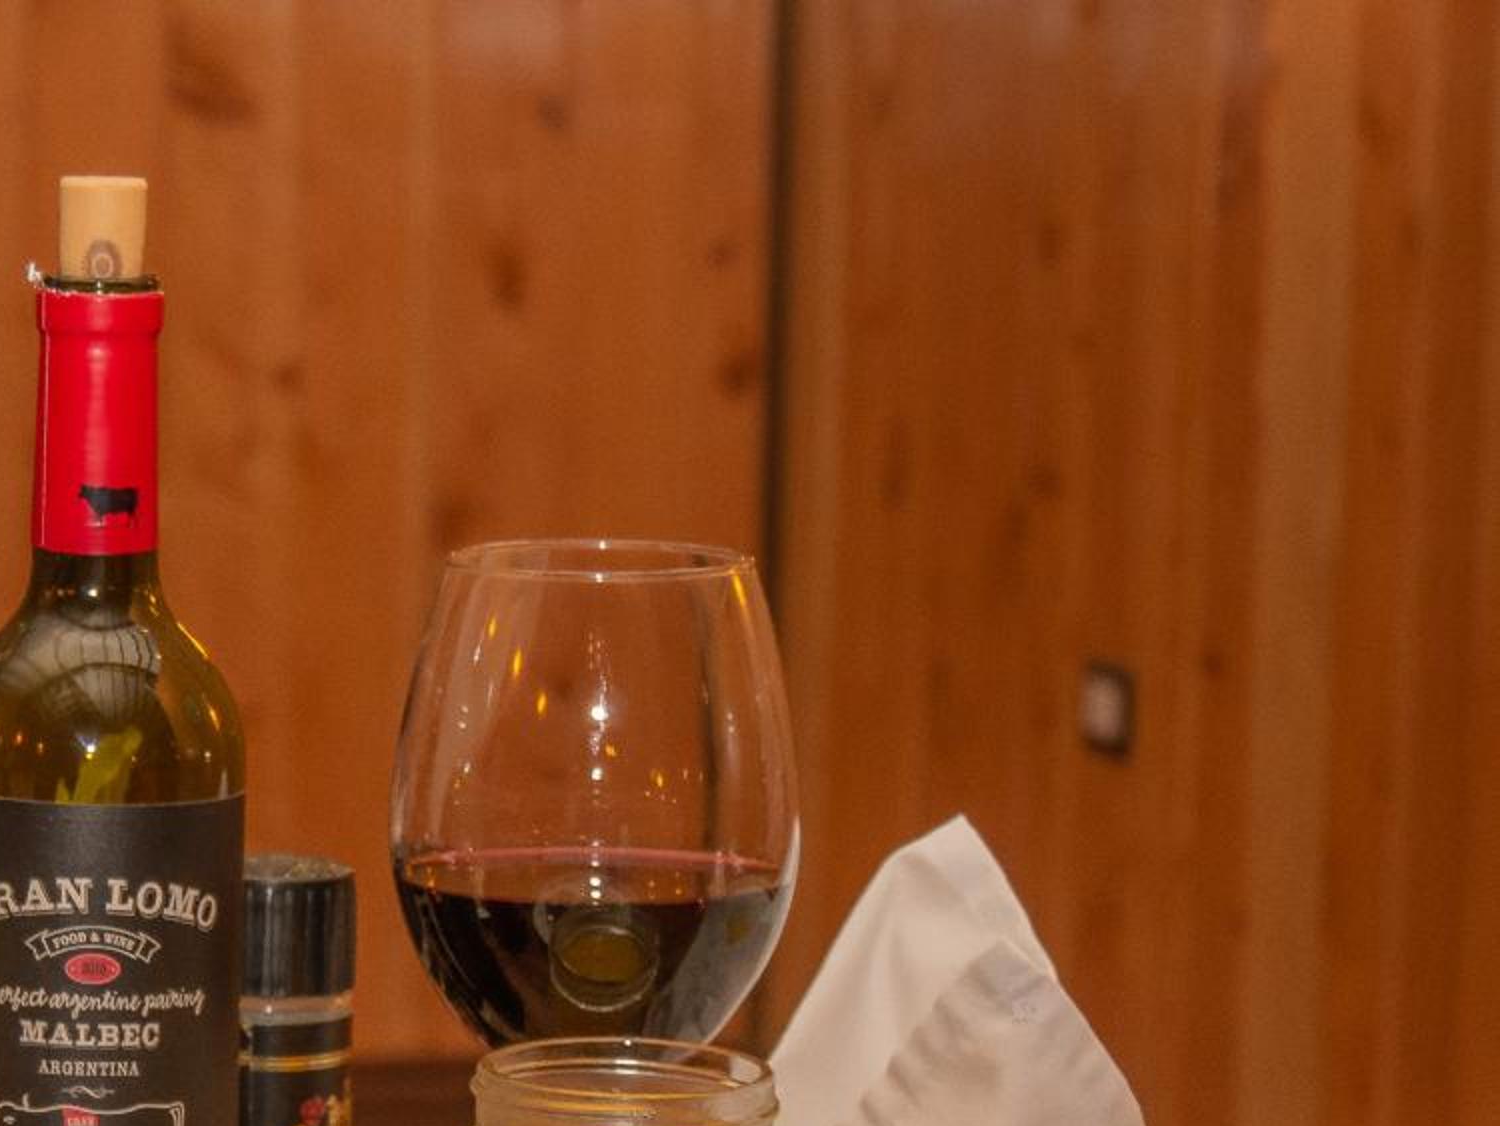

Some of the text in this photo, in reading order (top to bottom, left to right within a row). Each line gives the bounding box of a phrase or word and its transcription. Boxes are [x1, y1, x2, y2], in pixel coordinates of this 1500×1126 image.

[105, 878, 218, 931] LOMO
[52, 930, 87, 949] FOOD
[103, 932, 135, 951] WINE
[49, 986, 141, 1019] argentine
[142, 986, 206, 1017] pairing
[19, 1019, 161, 1051] MALBEC
[38, 1058, 140, 1078] ARGENTINA
